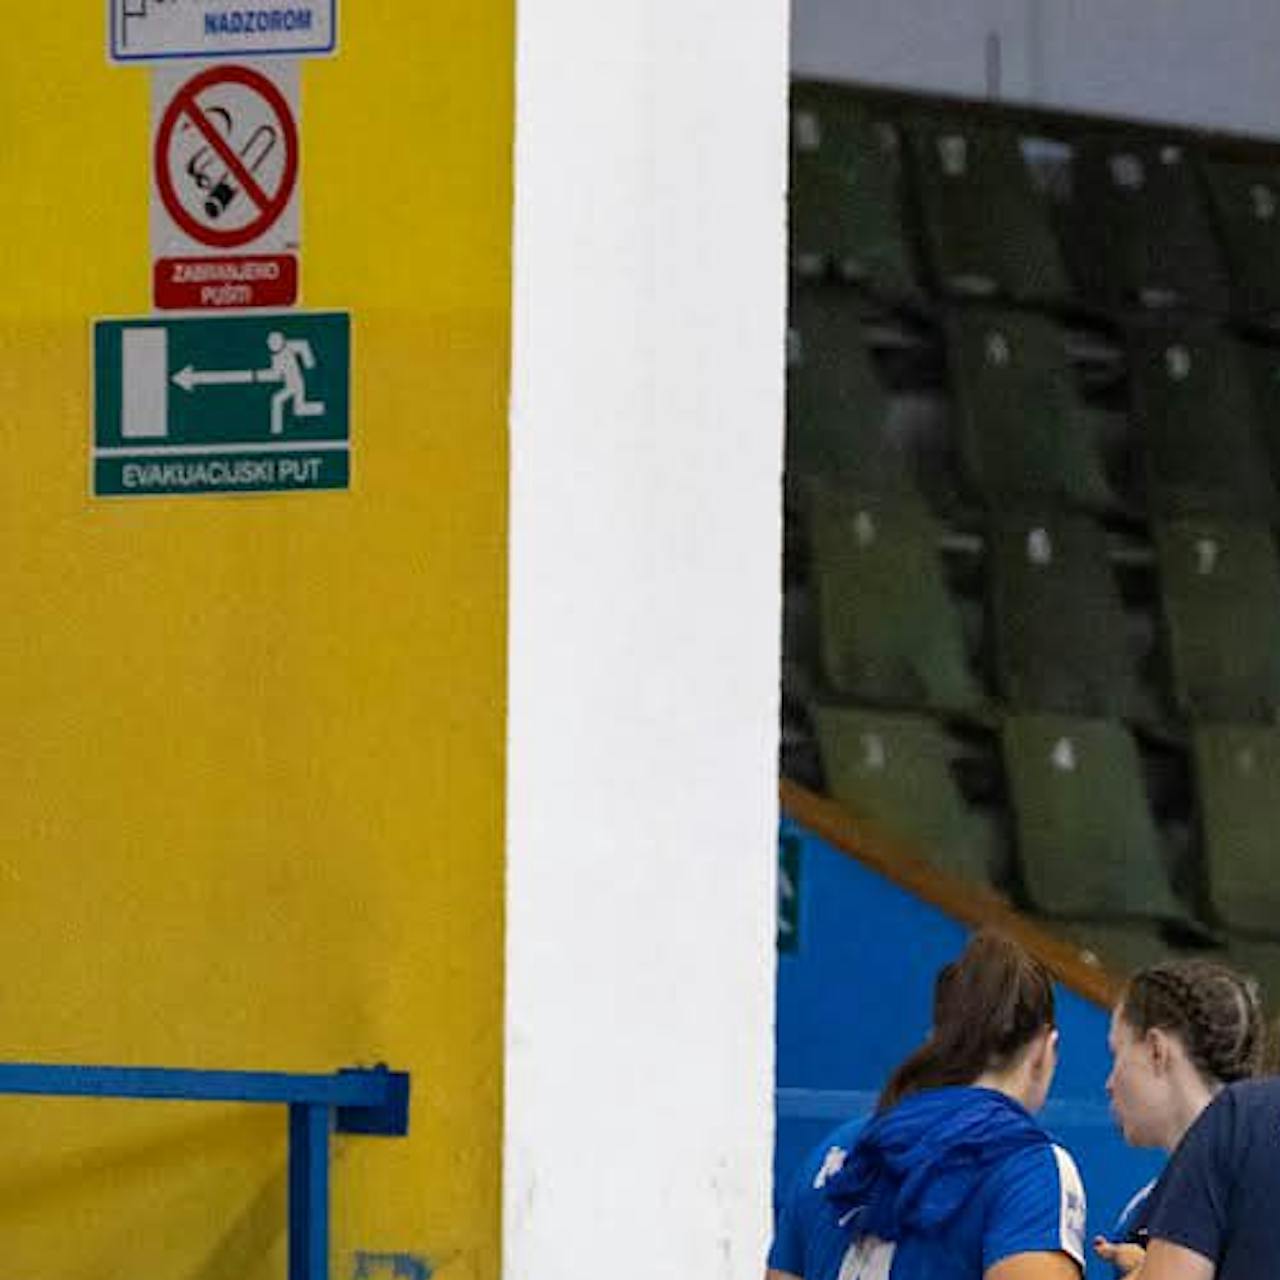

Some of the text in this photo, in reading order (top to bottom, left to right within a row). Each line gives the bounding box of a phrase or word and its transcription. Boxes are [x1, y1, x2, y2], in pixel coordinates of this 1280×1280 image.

[204, 9, 312, 34] NADZOROM
[122, 457, 322, 487] EVAKUACIJSKI PUT
